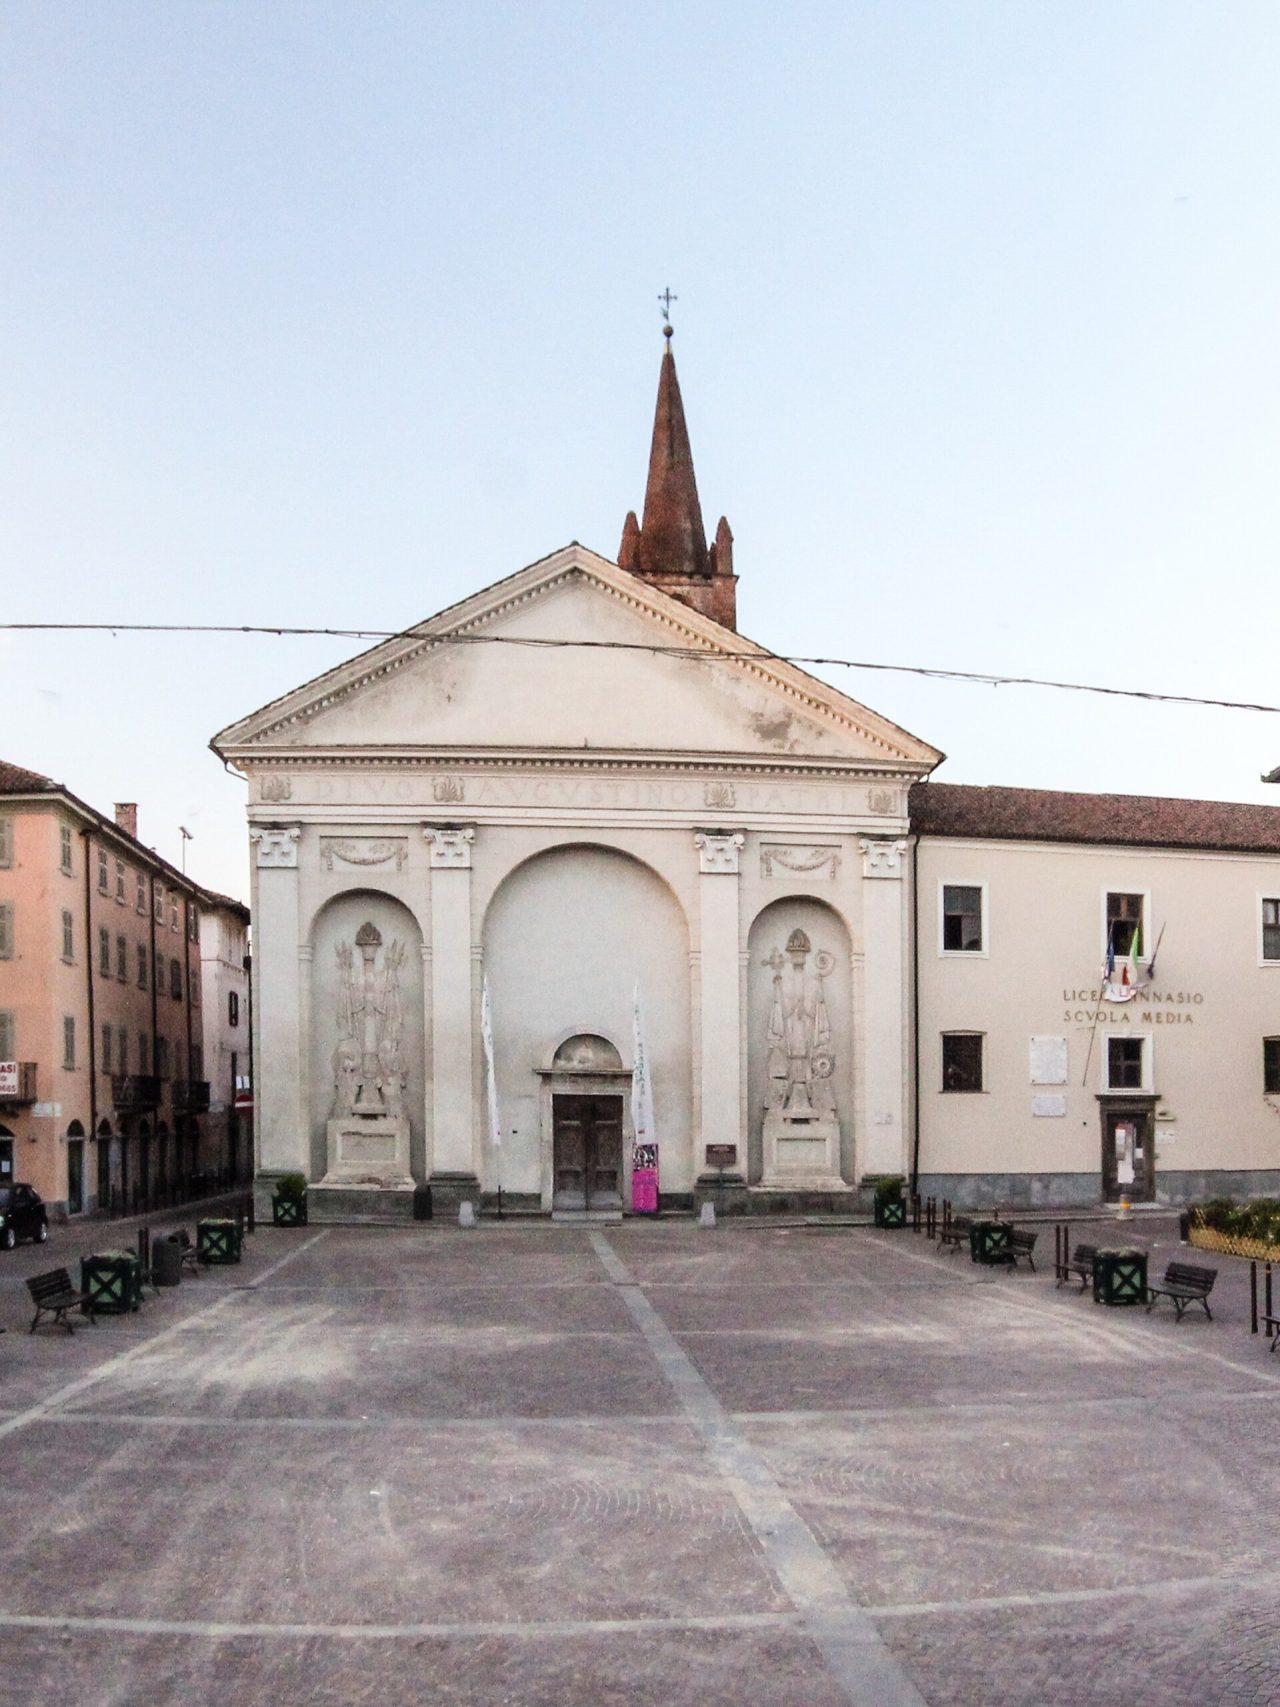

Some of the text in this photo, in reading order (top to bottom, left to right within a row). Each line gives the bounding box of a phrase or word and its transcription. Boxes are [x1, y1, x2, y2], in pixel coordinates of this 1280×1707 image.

[315, 778, 413, 800] DIVO
[477, 779, 688, 804] AVGVSTINO
[1131, 990, 1204, 1004] INNASIO
[1063, 1010, 1194, 1024] SCVOLA MEDIA
